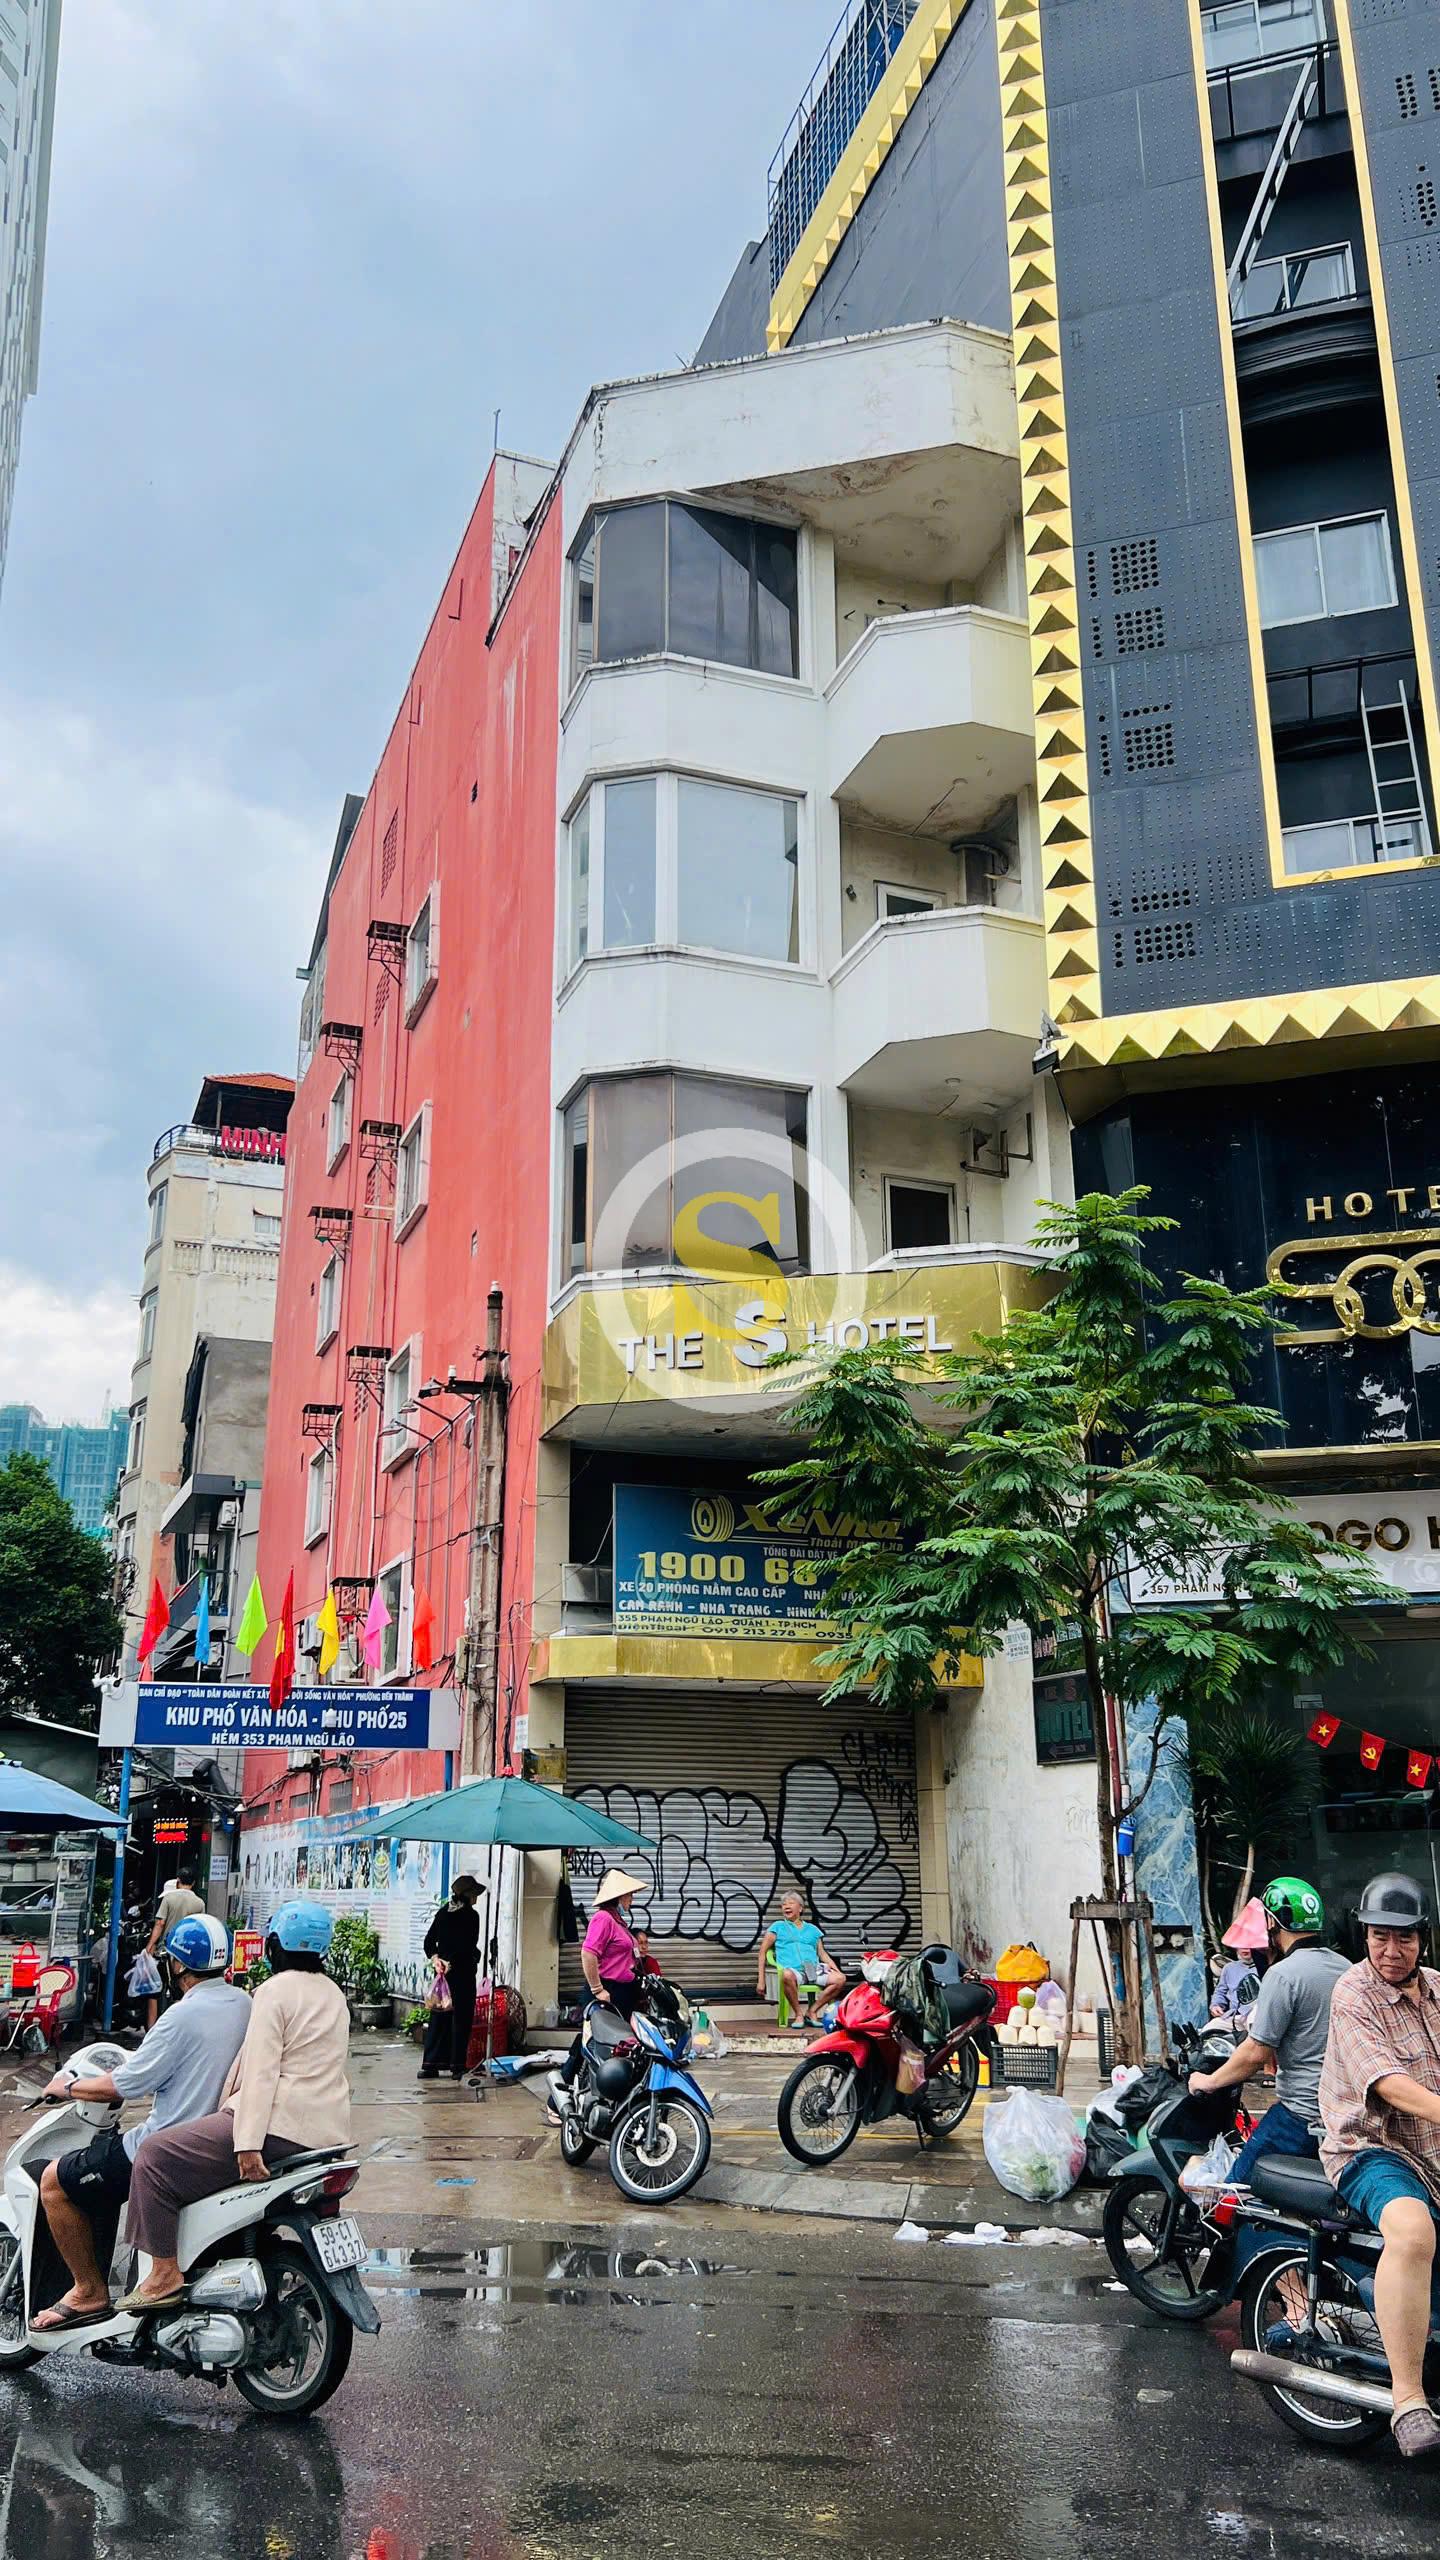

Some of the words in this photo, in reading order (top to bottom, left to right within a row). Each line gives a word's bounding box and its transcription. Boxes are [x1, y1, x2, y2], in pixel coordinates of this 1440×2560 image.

[618, 1332, 703, 1374] THE
[733, 1301, 788, 1368] S
[808, 1315, 953, 1354] HOTEL
[639, 1552, 746, 1582] 1900
[619, 1581, 635, 1592] XE
[639, 1582, 654, 1593] 20
[735, 1586, 758, 1598] CAO
[763, 1584, 787, 1599] CẤP
[1150, 1585, 1169, 1594] 357
[700, 1602, 726, 1615] NHA
[730, 1604, 771, 1616] TRANG
[770, 1629, 796, 1637] 278
[139, 1688, 153, 1697] BAN
[166, 1706, 200, 1726] KHU
[202, 1701, 238, 1727] PHỐ
[240, 1705, 273, 1728] VĂN
[275, 1704, 308, 1728] HÓA
[211, 1729, 240, 1745] HẺM
[242, 1733, 265, 1745] 353
[305, 1732, 329, 1746] NGŨ
[331, 1732, 355, 1747] LÃO
